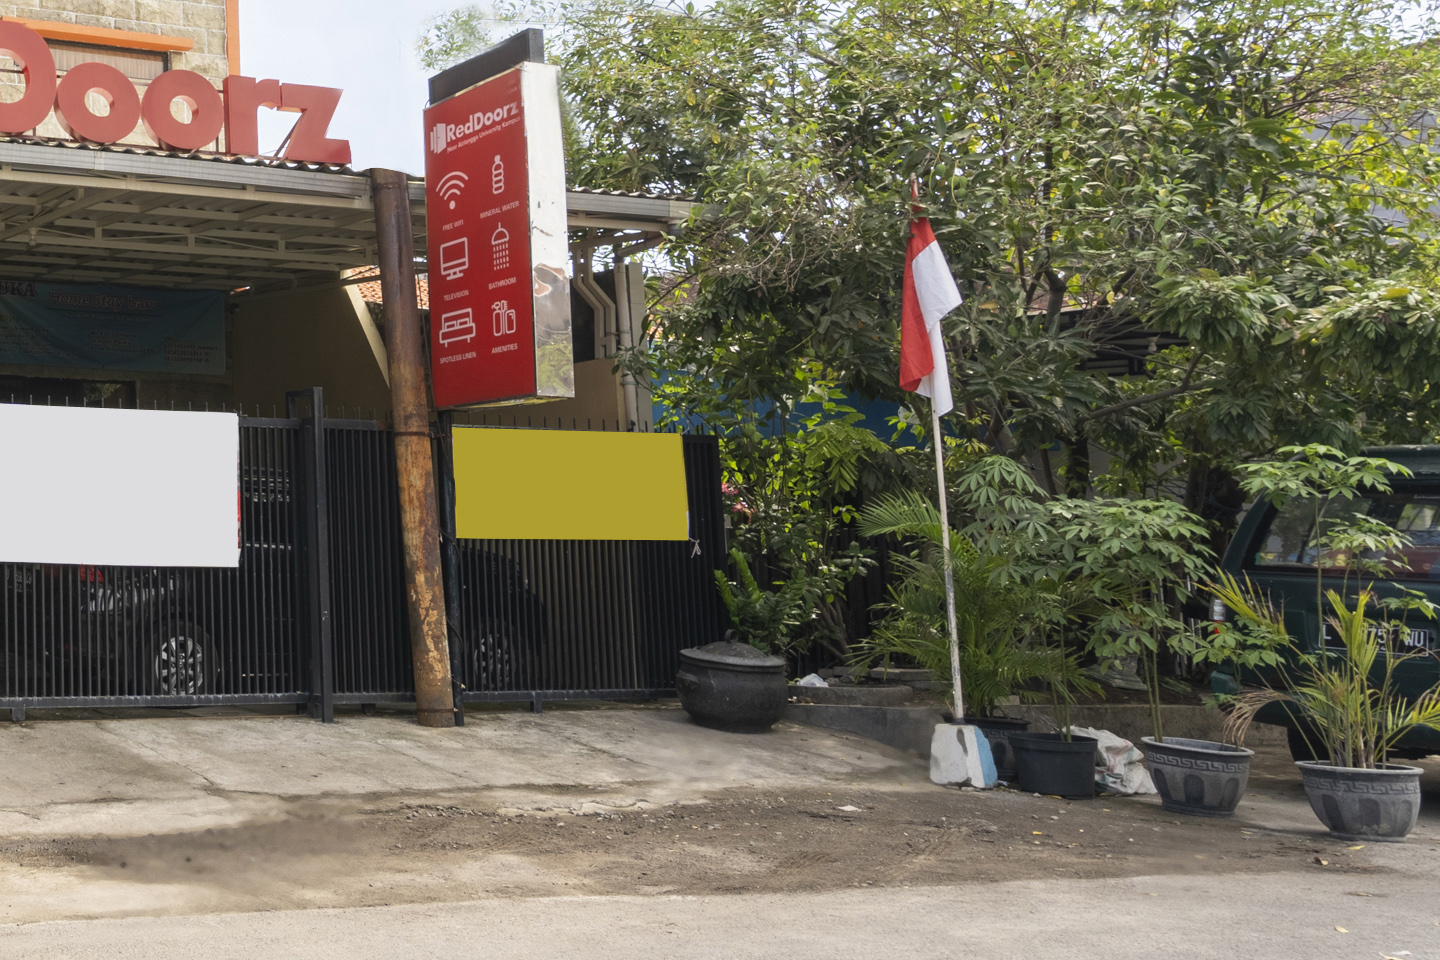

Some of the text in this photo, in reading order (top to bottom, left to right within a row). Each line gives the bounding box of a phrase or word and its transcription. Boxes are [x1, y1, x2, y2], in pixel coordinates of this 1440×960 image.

[446, 101, 519, 143] RedDoorz
[479, 124, 502, 138] University
[502, 116, 521, 128] Kampus
[480, 200, 520, 219] MINERAL WATER
[442, 223, 454, 231] FREE
[488, 277, 517, 290] BATHROOM
[443, 289, 469, 301] TELEVISION
[491, 343, 518, 354] AMENITIES
[440, 351, 477, 365] SPOTLESS LINEN
